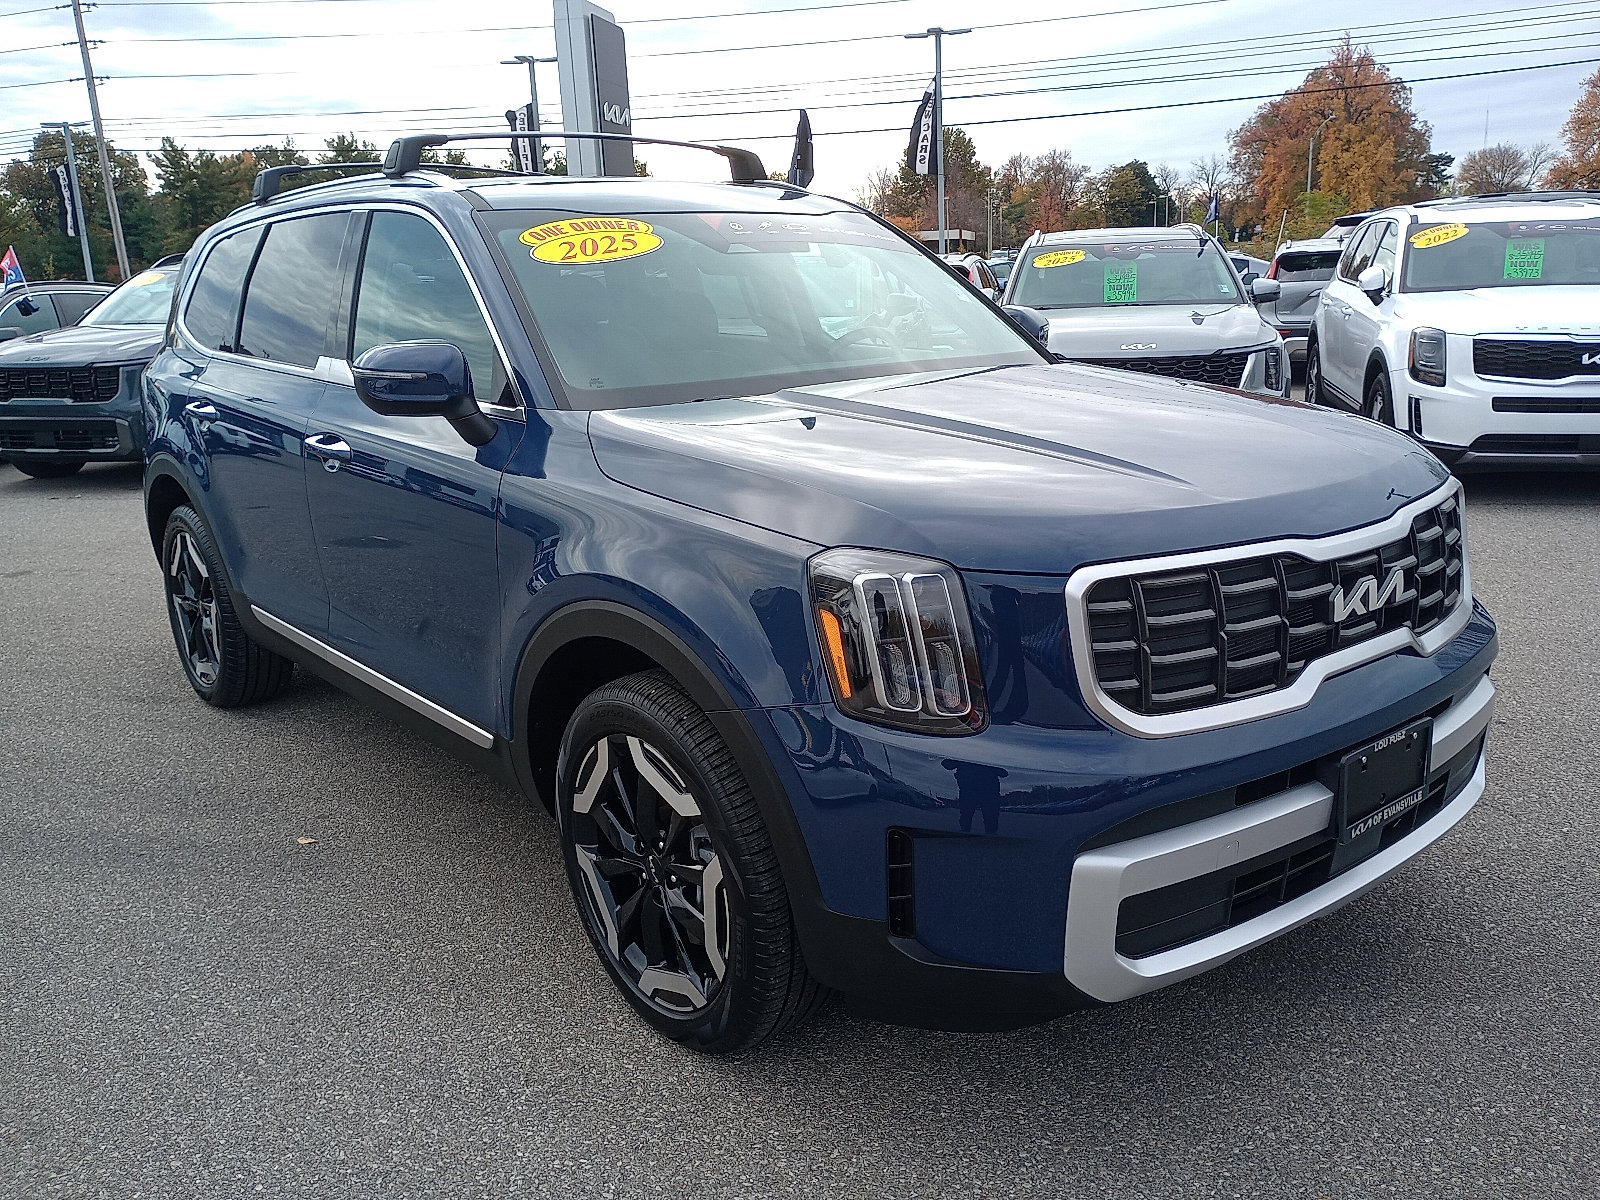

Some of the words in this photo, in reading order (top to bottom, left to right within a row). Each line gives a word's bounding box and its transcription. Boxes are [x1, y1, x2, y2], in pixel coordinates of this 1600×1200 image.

[528, 224, 569, 241] ONE
[568, 220, 640, 232] OWNER
[1425, 230, 1458, 246] 2022
[558, 233, 638, 260] 2025
[1329, 566, 1404, 623] KIA
[1374, 738, 1388, 752] LOU
[1389, 730, 1406, 745] FUSZ
[1351, 818, 1373, 839] KIA
[1373, 812, 1382, 825] OF
[1383, 790, 1423, 820] EVANSVILLE
